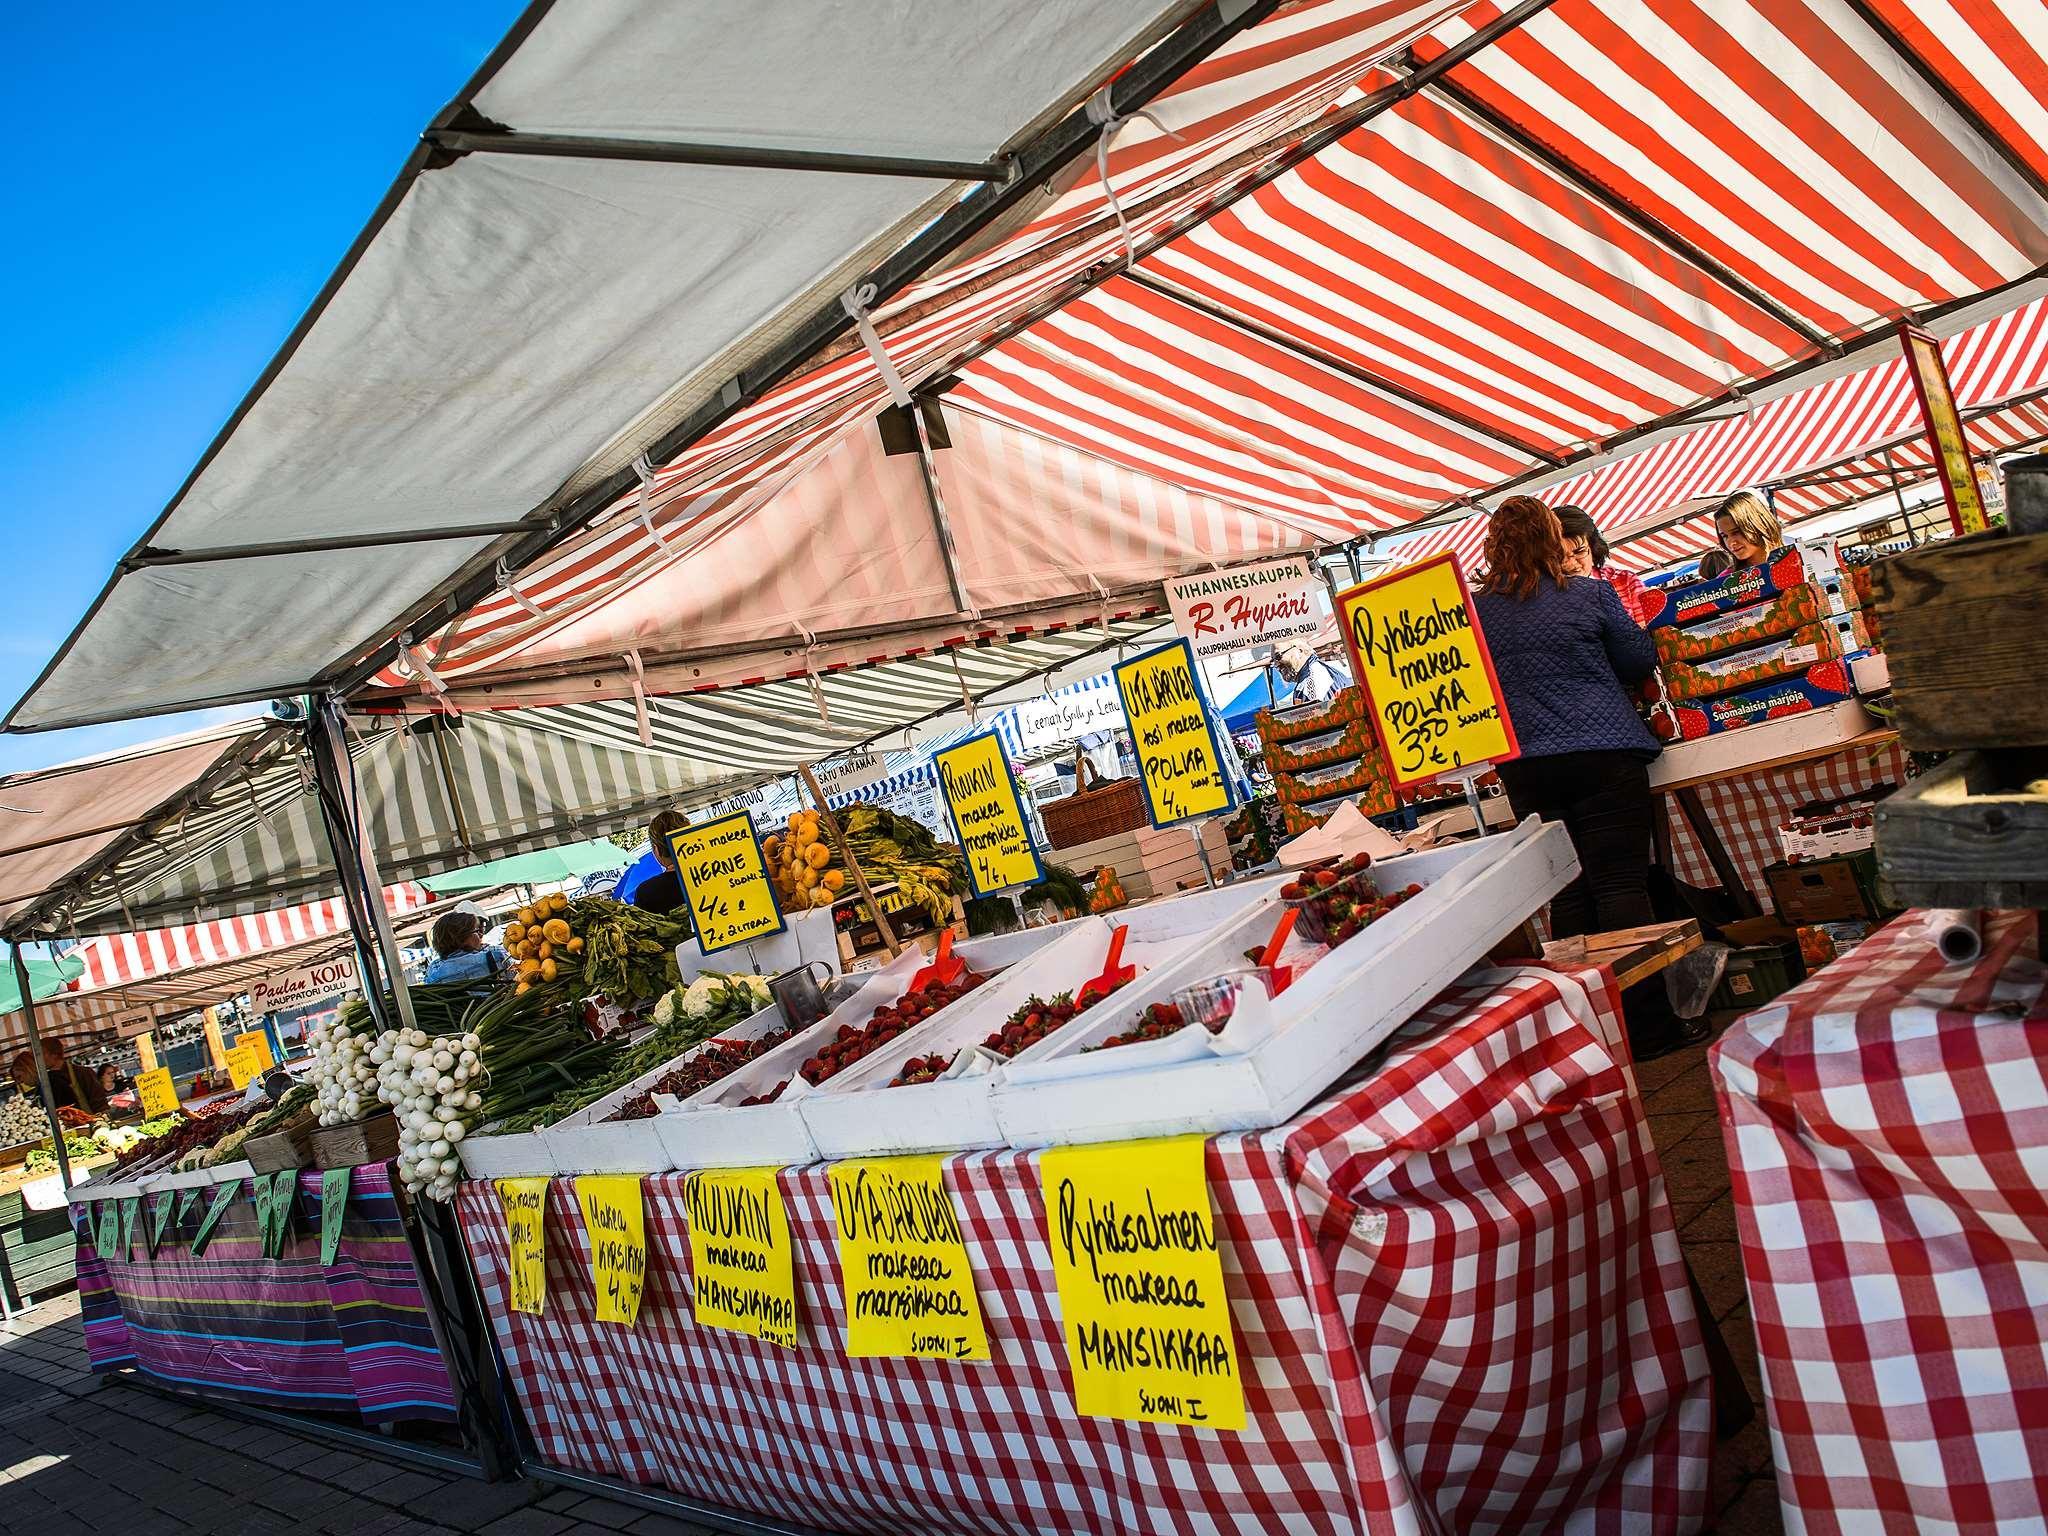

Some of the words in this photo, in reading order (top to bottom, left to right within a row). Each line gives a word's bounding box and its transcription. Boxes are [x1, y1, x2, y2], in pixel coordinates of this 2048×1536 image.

[1174, 564, 1303, 600] VIHANNESKAUPPA
[1676, 586, 1729, 611] Suomalaisia
[1730, 577, 1765, 598] marjoja
[1224, 592, 1310, 632] Hyväri
[1197, 638, 1246, 656] KAUPPAHALLI
[1251, 628, 1294, 644] KAUPPATORI
[1299, 622, 1317, 633] OULU
[1399, 645, 1470, 689] makea
[1384, 678, 1471, 733] POLKA
[1713, 699, 1766, 722] Suomalaisia
[1768, 691, 1804, 710] marjoja
[1167, 714, 1204, 739] makea
[819, 769, 837, 784] SATU
[839, 755, 877, 776] RAITAMAA
[1145, 747, 1207, 788] POLKA
[822, 783, 841, 797] OULU
[961, 800, 1004, 827] makea
[677, 839, 705, 860] Tosi
[709, 828, 750, 848] makea
[689, 853, 746, 887] HERNE
[253, 978, 306, 1001] Paulan
[310, 962, 353, 986] KOJU
[267, 988, 321, 1007] KAUPPATORI
[323, 981, 346, 993] OULU
[589, 1193, 627, 1232] Makea
[835, 1168, 960, 1245] UTAJÄRVEN
[1059, 1177, 1217, 1283] Pyhäsalmen
[706, 1243, 769, 1273] makeaa
[868, 1250, 951, 1281] makeaa
[697, 1275, 792, 1328] MANSIKKAA
[856, 1285, 968, 1320] mansikkaa
[1102, 1269, 1205, 1308] makeaa
[912, 1332, 950, 1354] SUOMI
[955, 1337, 972, 1357] I
[1077, 1320, 1231, 1377] MANSIKKAA
[1139, 1389, 1182, 1416] SUOMI
[1186, 1399, 1207, 1420] I
